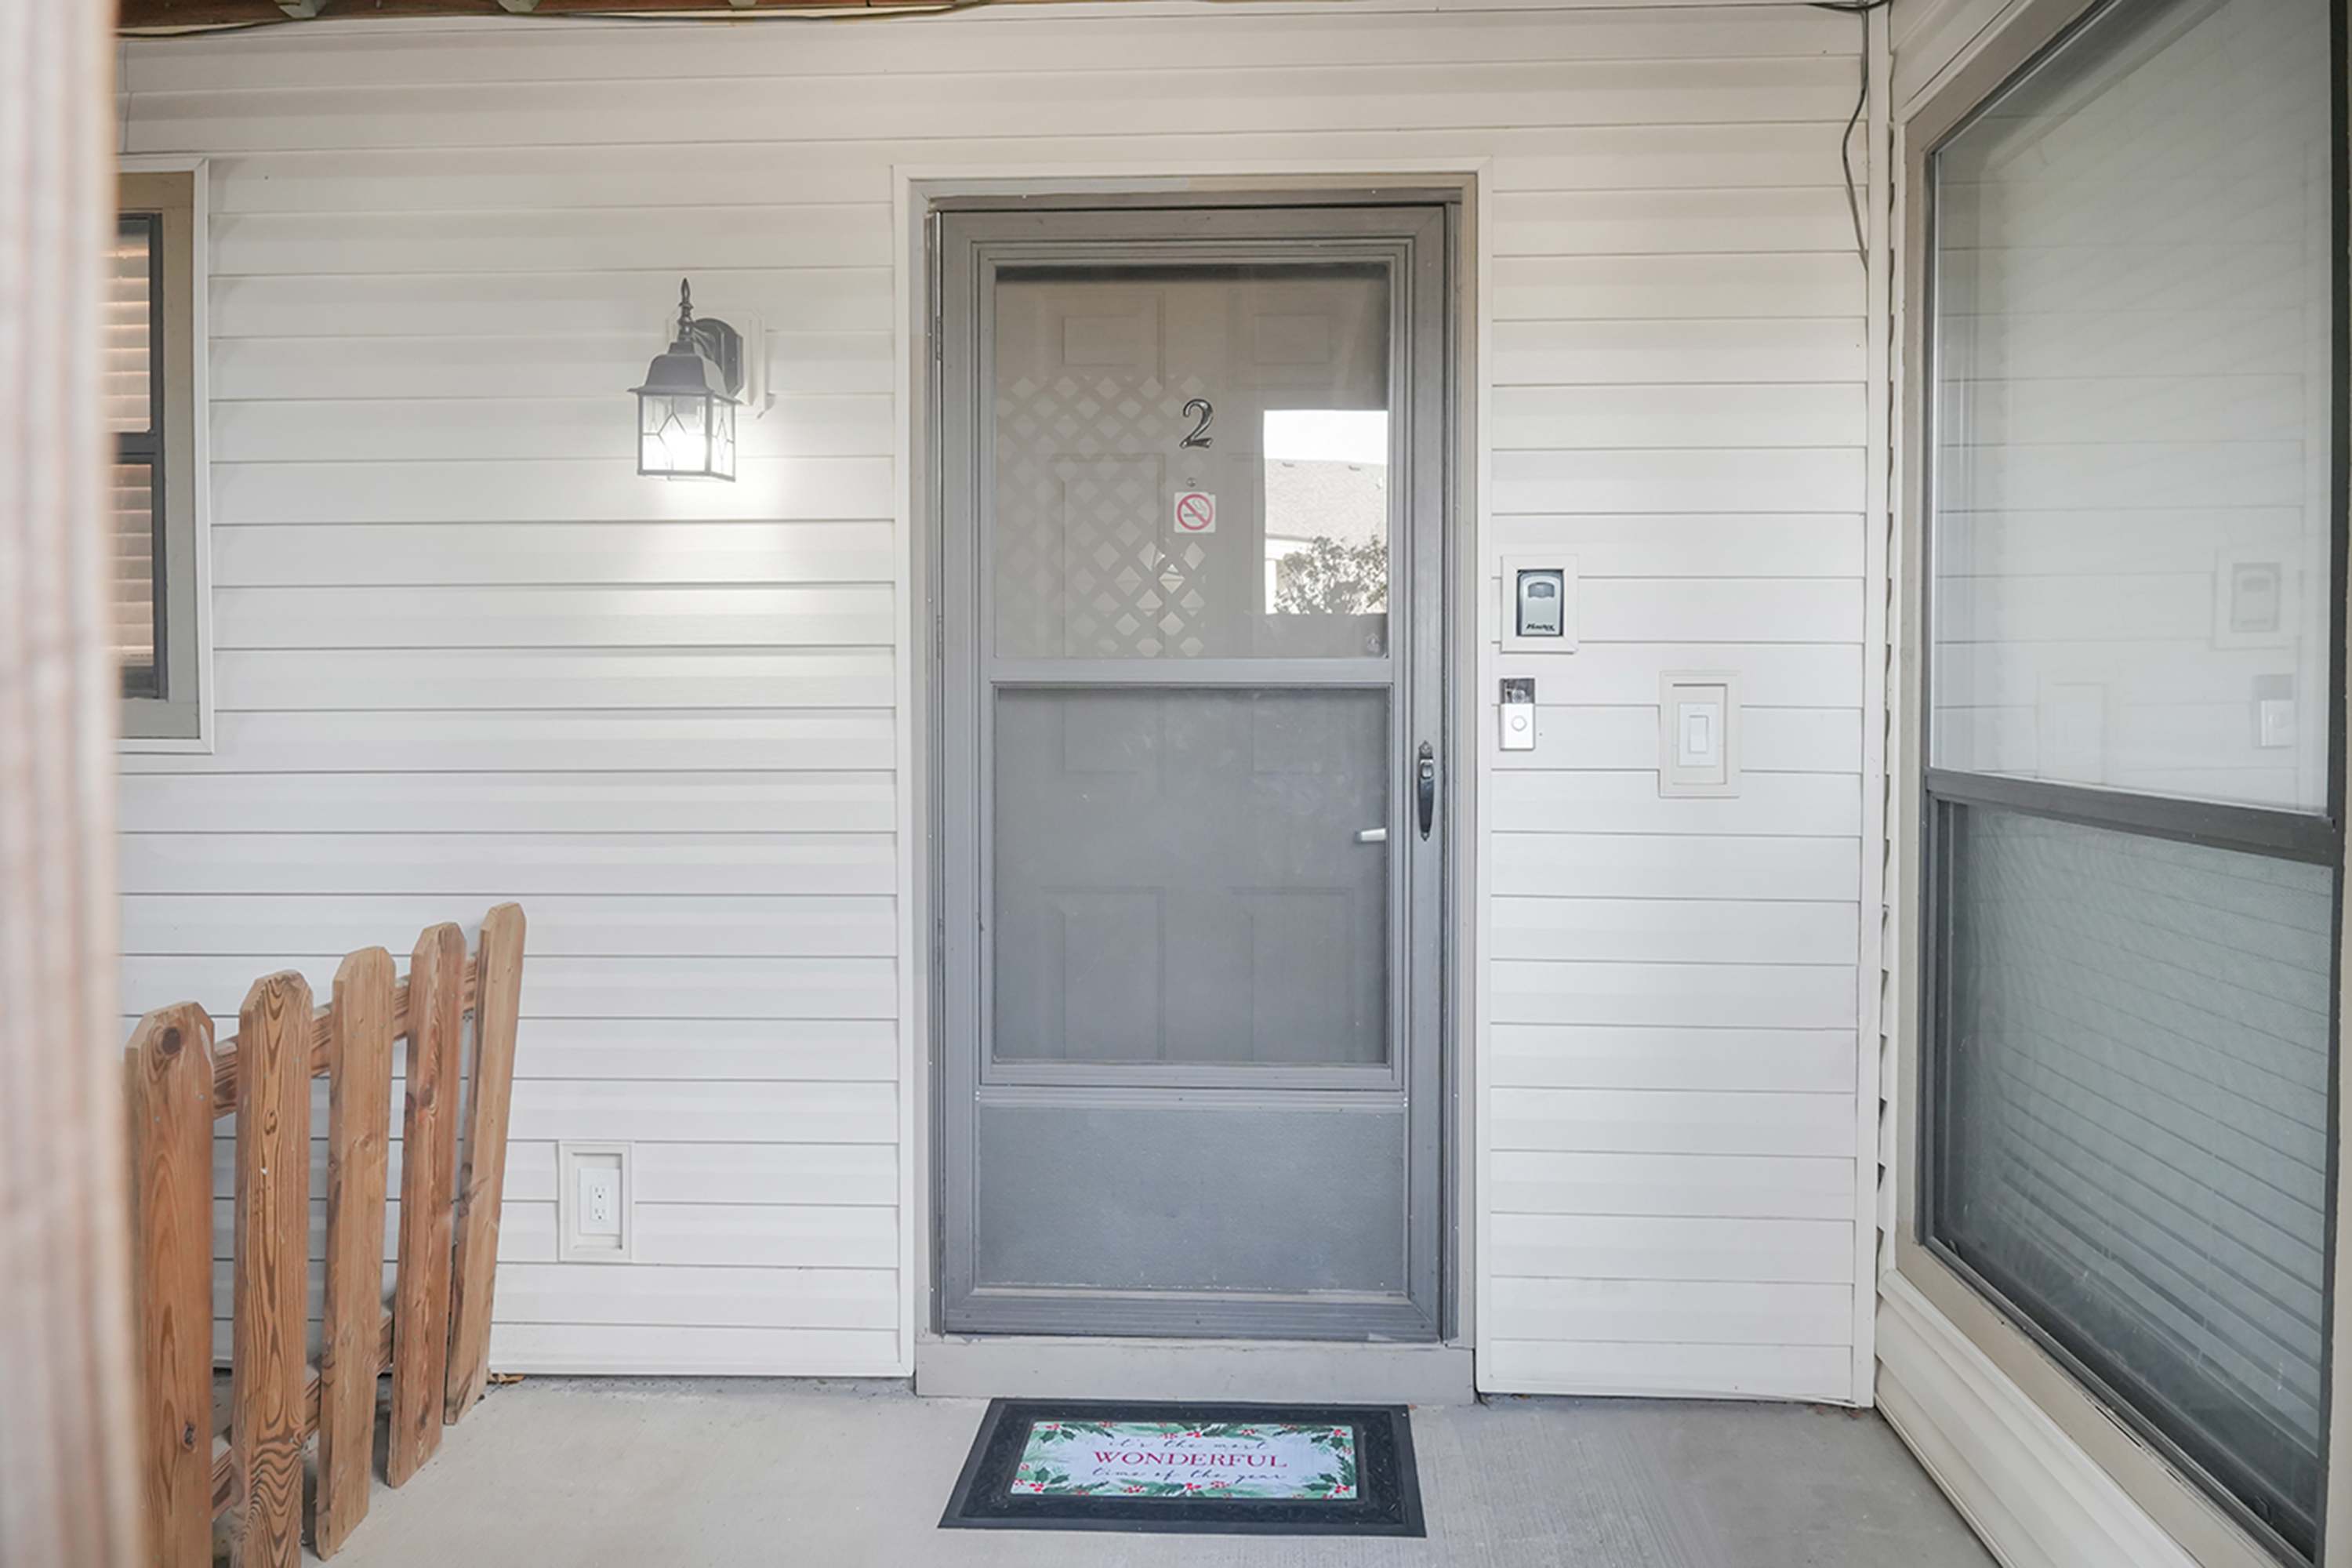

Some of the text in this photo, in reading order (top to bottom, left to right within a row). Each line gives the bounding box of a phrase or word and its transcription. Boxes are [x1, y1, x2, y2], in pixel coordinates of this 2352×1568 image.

[1179, 398, 1214, 449] 2
[1163, 1439, 1201, 1449] the
[1212, 1441, 1266, 1450] most
[1094, 1450, 1288, 1467] WONDERFUL
[1092, 1467, 1144, 1476] time
[1154, 1468, 1176, 1482] of
[1189, 1468, 1225, 1478] the
